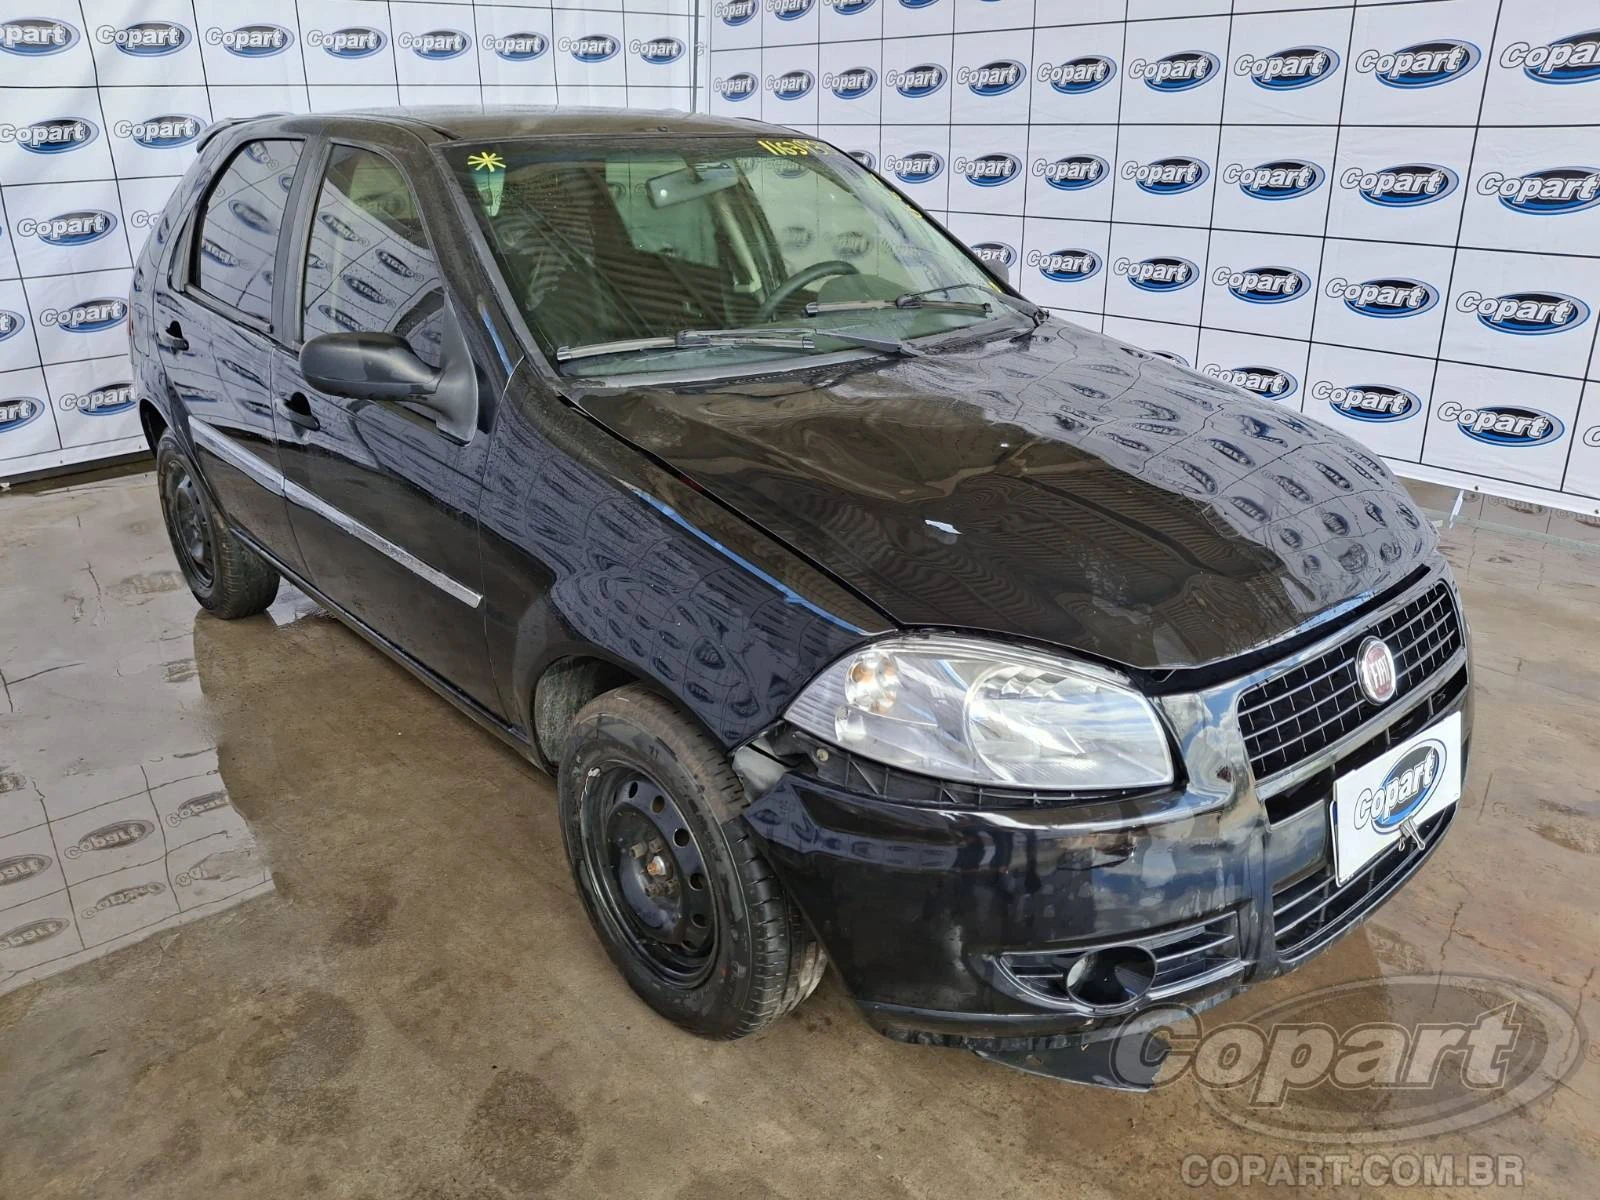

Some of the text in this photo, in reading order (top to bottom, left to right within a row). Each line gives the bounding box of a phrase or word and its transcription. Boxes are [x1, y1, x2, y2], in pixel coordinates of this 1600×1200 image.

[715, 0, 756, 20] Copart
[96, 25, 179, 48] Copart
[206, 27, 284, 49] Copart
[307, 30, 378, 51] Copart
[398, 32, 463, 54] Copart
[482, 34, 542, 54] Copart
[558, 37, 614, 55] Copart
[630, 39, 681, 57] Copart
[1129, 55, 1209, 83] Copart
[1234, 52, 1327, 81] Copart
[1356, 46, 1466, 79] Copart
[1500, 41, 1600, 74] Copa
[765, 73, 809, 94] Copart
[822, 71, 871, 92] Copart
[886, 67, 941, 91] Copart
[957, 64, 1019, 87] Copart
[1037, 59, 1108, 86] Copart
[713, 76, 755, 96] Copart
[0, 122, 86, 146] Copart
[114, 119, 194, 142] Copart
[885, 155, 937, 176] Copart
[954, 157, 1017, 180] Copart
[1032, 158, 1100, 182] Copart
[1121, 161, 1199, 186] Copart
[1223, 164, 1314, 191] Copart
[1340, 167, 1444, 197] Copart
[1477, 172, 1600, 204] Copart
[17, 212, 105, 240] Copart
[1027, 250, 1094, 273] Copart
[1114, 257, 1189, 283] Copart
[1212, 267, 1299, 295] Copart
[1325, 278, 1425, 308] Copart
[40, 300, 123, 328] Copart
[1456, 291, 1573, 325] Copart
[1312, 381, 1408, 414] Copart
[1437, 401, 1549, 439] Copart
[1369, 655, 1391, 689] FIAT
[1354, 747, 1436, 831] Copart
